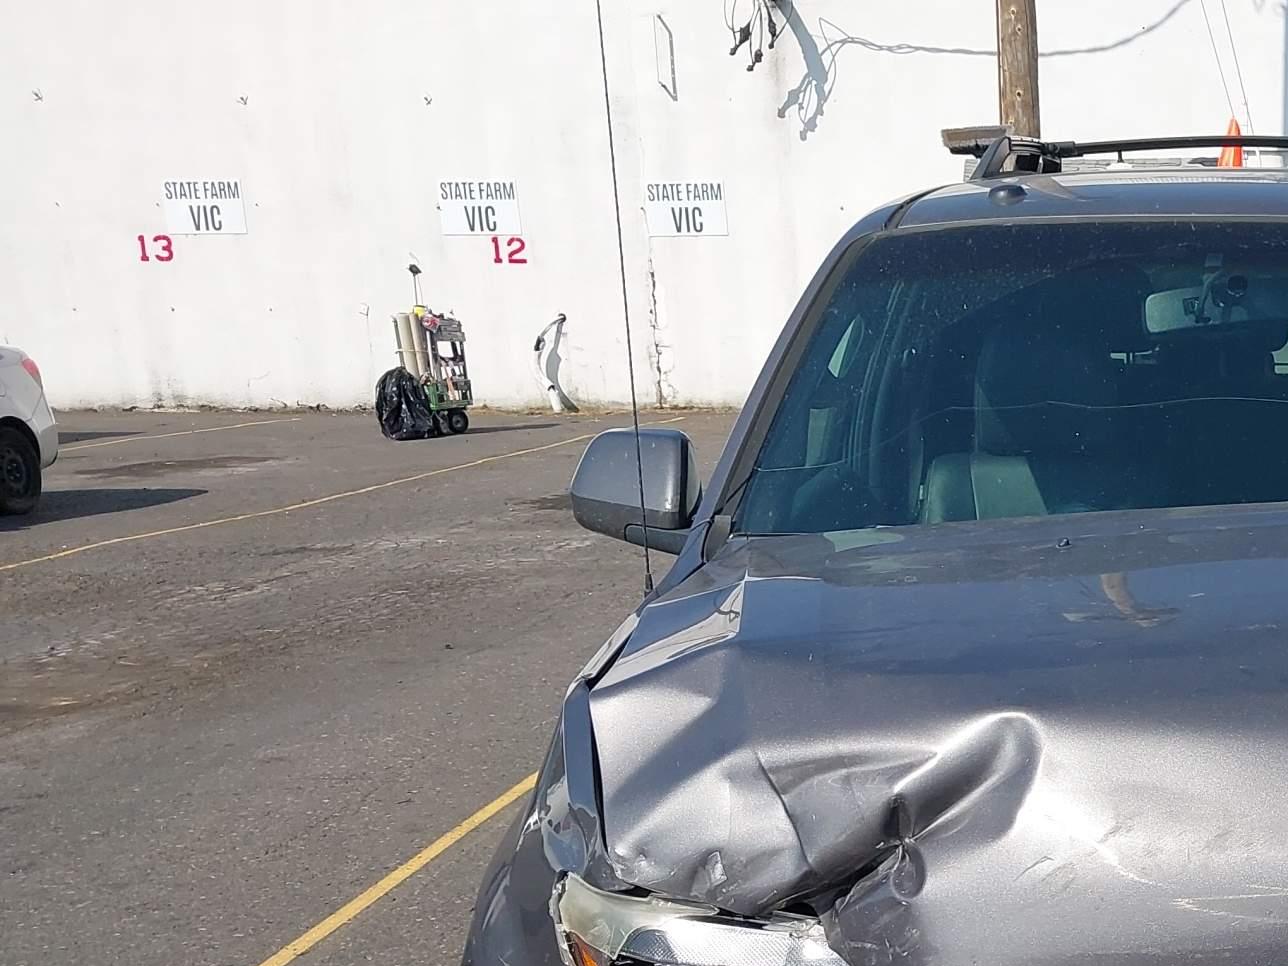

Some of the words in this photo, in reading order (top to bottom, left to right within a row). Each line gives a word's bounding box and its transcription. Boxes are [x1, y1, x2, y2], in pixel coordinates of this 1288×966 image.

[164, 181, 201, 200] STATE
[203, 181, 240, 200] FARM
[440, 181, 476, 201] STATE
[478, 181, 515, 201] FARM
[647, 183, 683, 202] STATE
[686, 183, 722, 202] FARM
[188, 204, 223, 232] VIC
[464, 205, 497, 232] VIC
[671, 206, 704, 233] VIC
[137, 234, 174, 262] 13
[491, 236, 528, 264] 12
